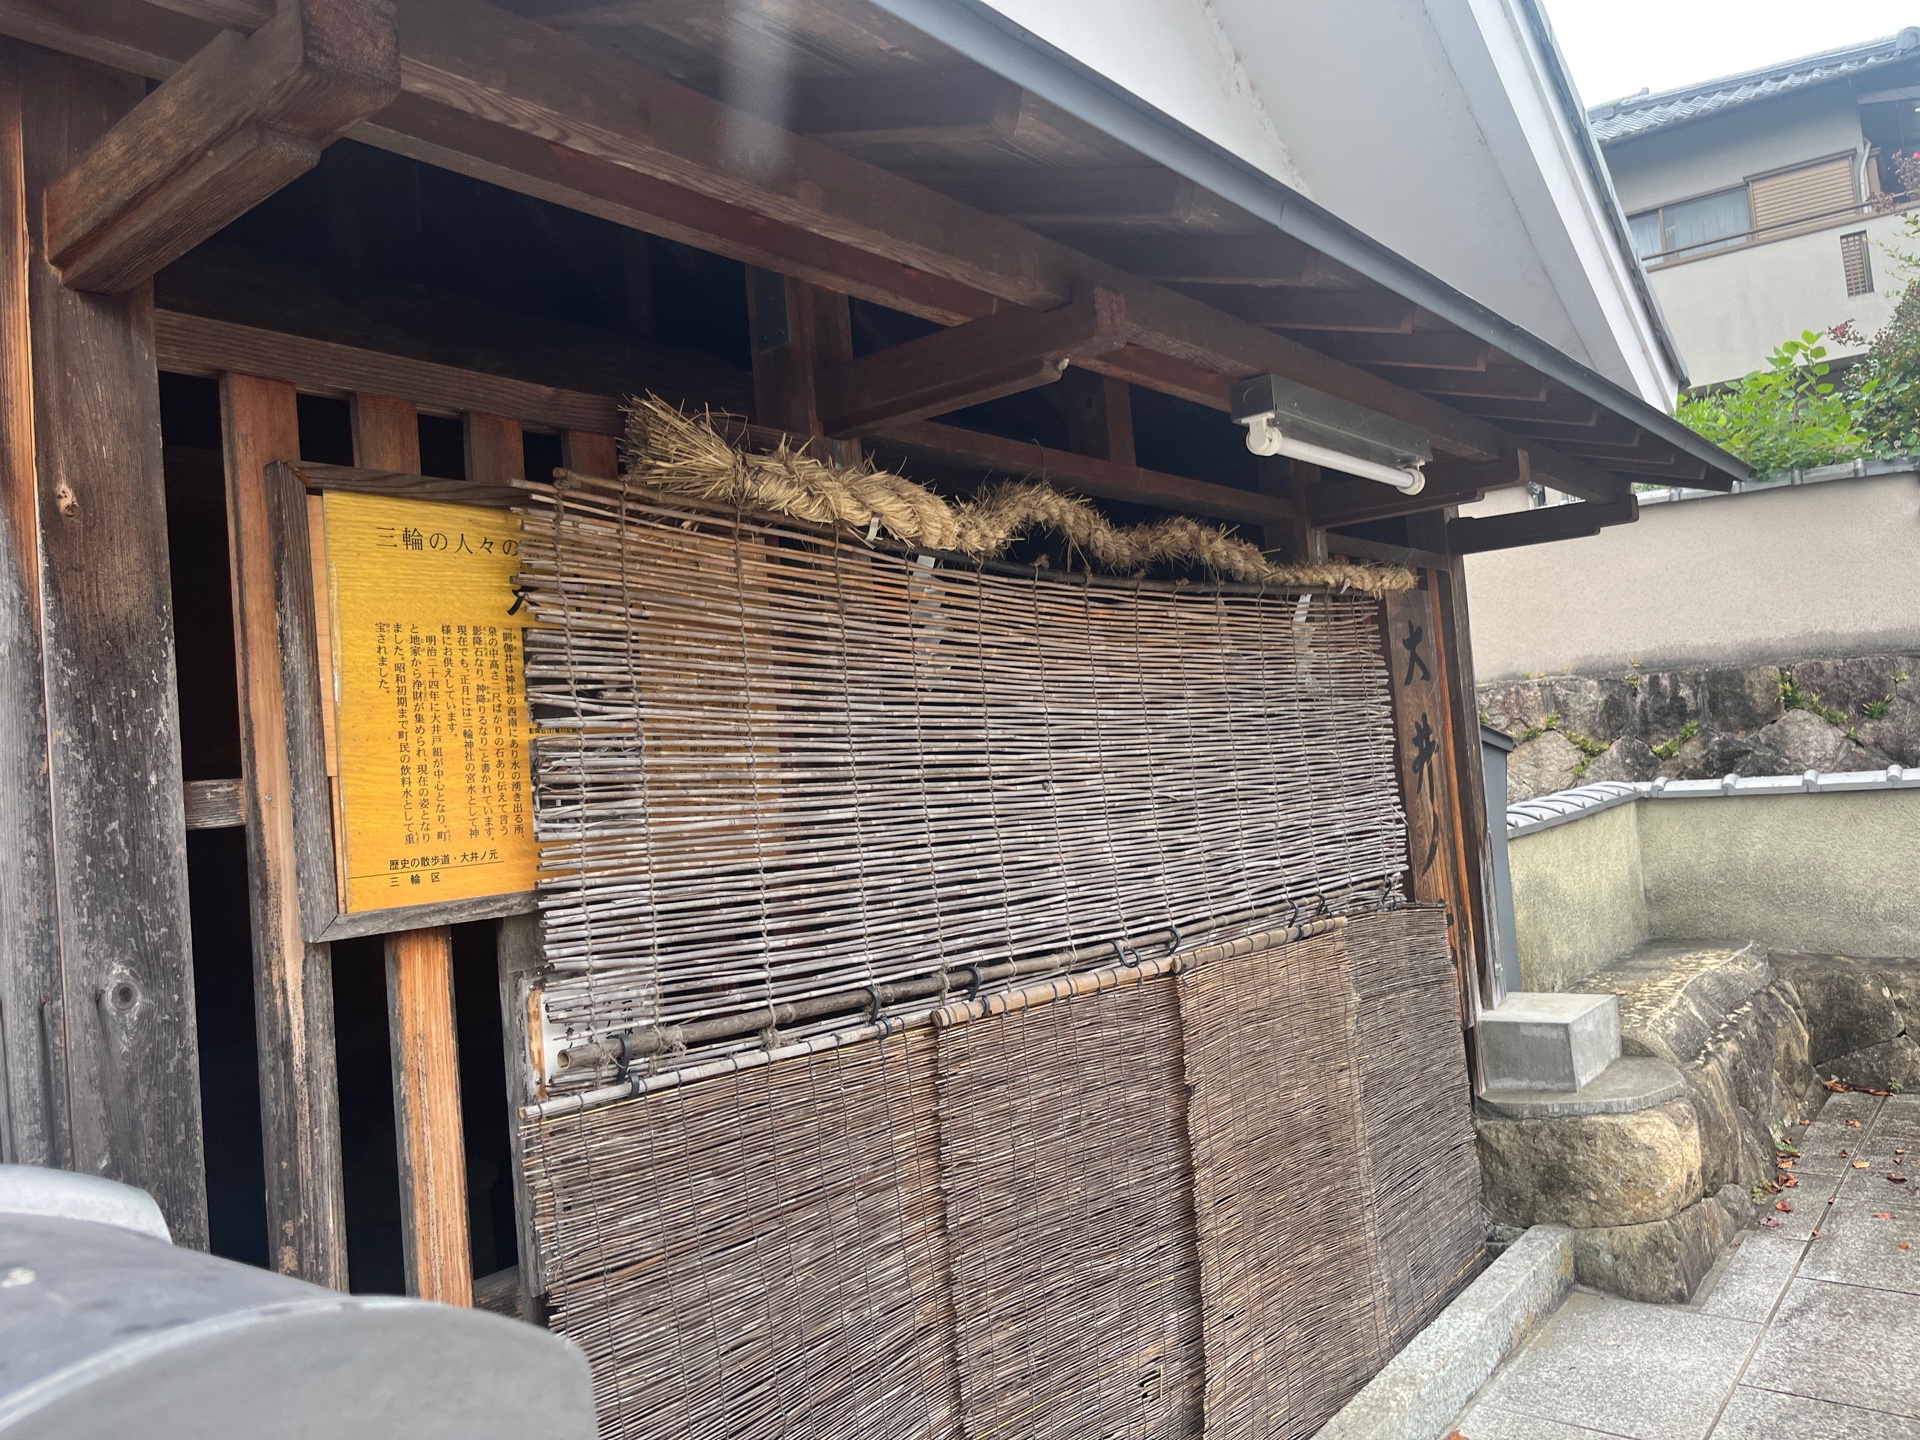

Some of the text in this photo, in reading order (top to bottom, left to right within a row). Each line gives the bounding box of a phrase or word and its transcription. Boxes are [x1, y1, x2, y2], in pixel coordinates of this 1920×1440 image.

[375, 622, 390, 694] 宝されました。
[441, 624, 458, 738] 様にお供えしています。
